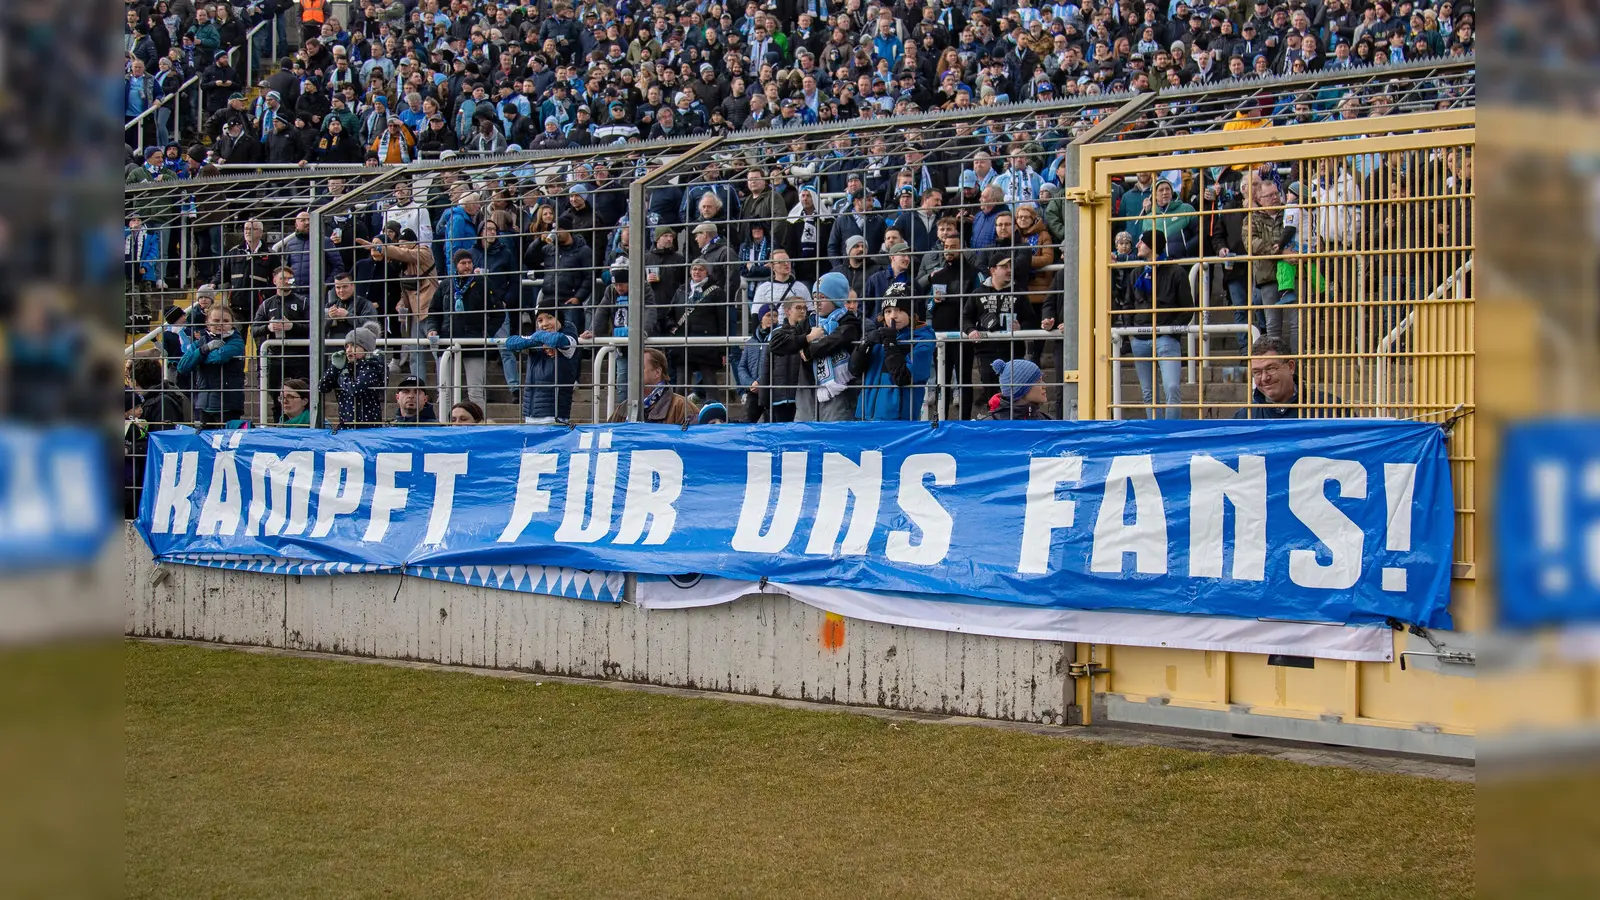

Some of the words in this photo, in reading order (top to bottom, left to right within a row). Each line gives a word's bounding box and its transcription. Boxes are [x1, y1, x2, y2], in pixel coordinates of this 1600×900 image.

[152, 431, 468, 546] KÄMPFT
[497, 429, 683, 544] FÜR
[732, 451, 956, 565] UNS
[1018, 455, 1417, 591] FANS!
